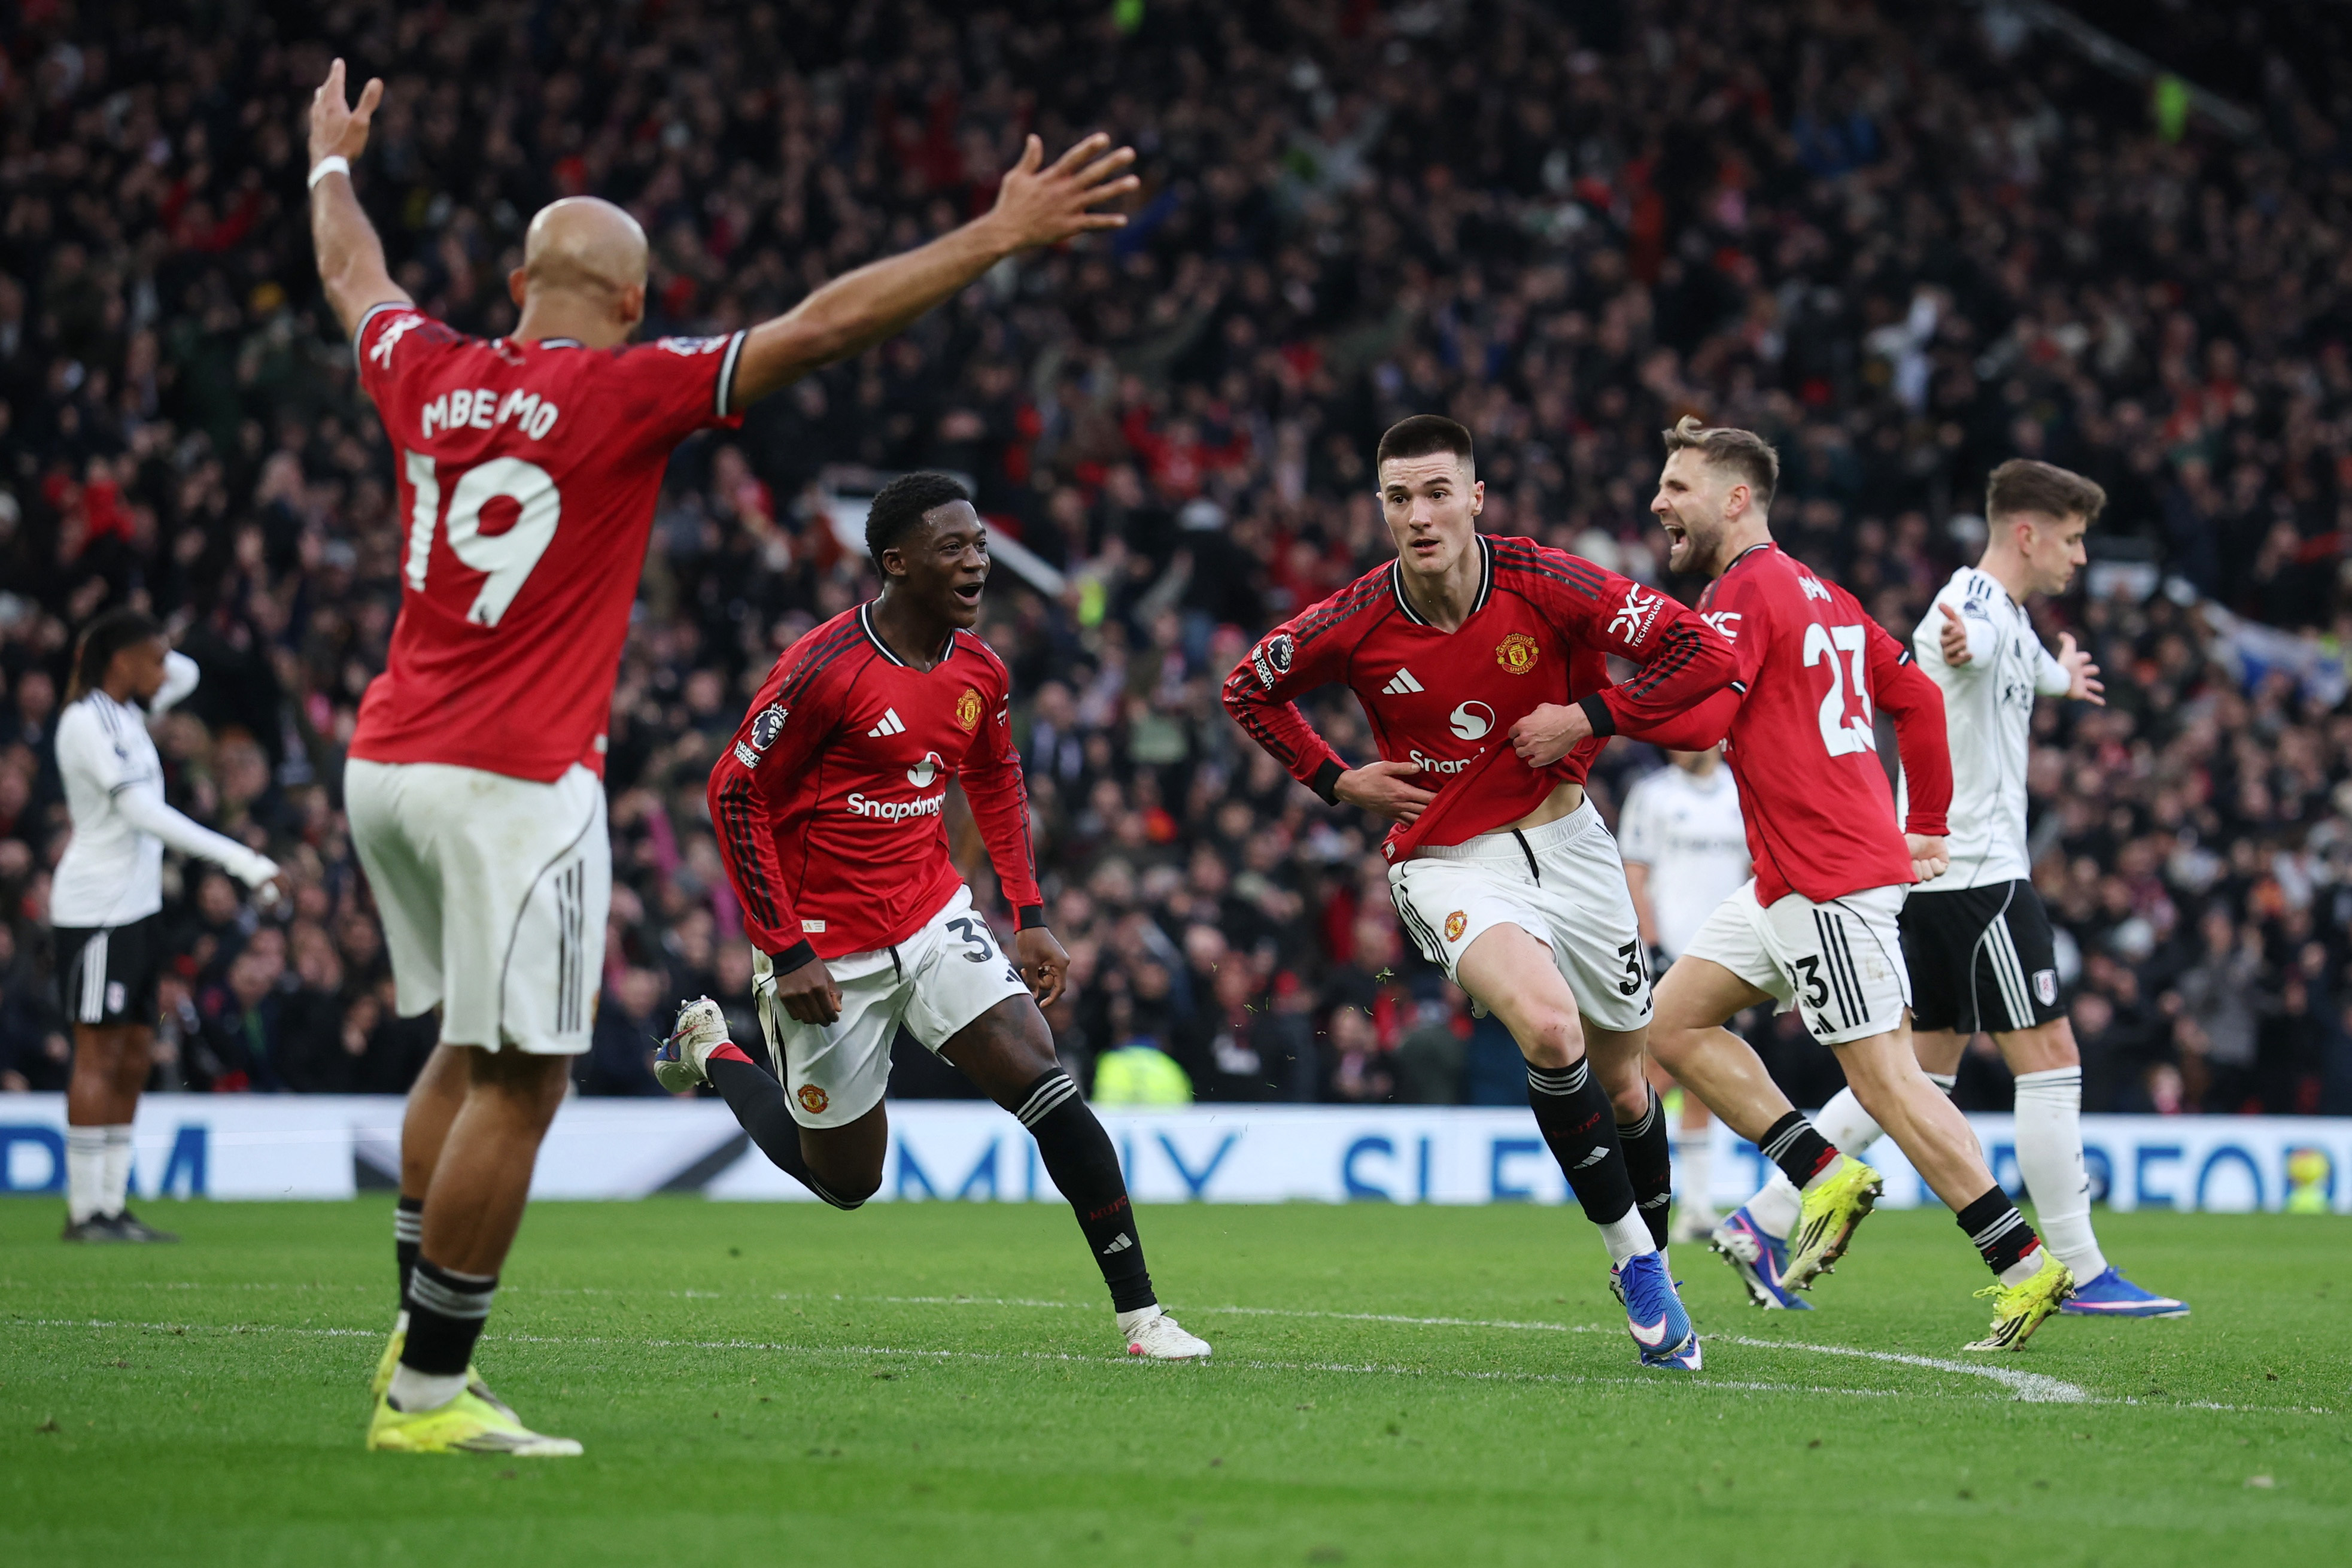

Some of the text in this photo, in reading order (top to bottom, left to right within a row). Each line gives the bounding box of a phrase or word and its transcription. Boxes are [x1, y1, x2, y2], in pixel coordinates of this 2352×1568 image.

[422, 388, 559, 440] MBEMO
[405, 449, 561, 627] 19
[1607, 582, 1657, 644] DXC
[1632, 597, 1666, 648] TECHNOLOGY
[1499, 636, 1533, 654] MANCHESTER
[1510, 661, 1533, 671] UNITED
[1803, 622, 1876, 757] 23
